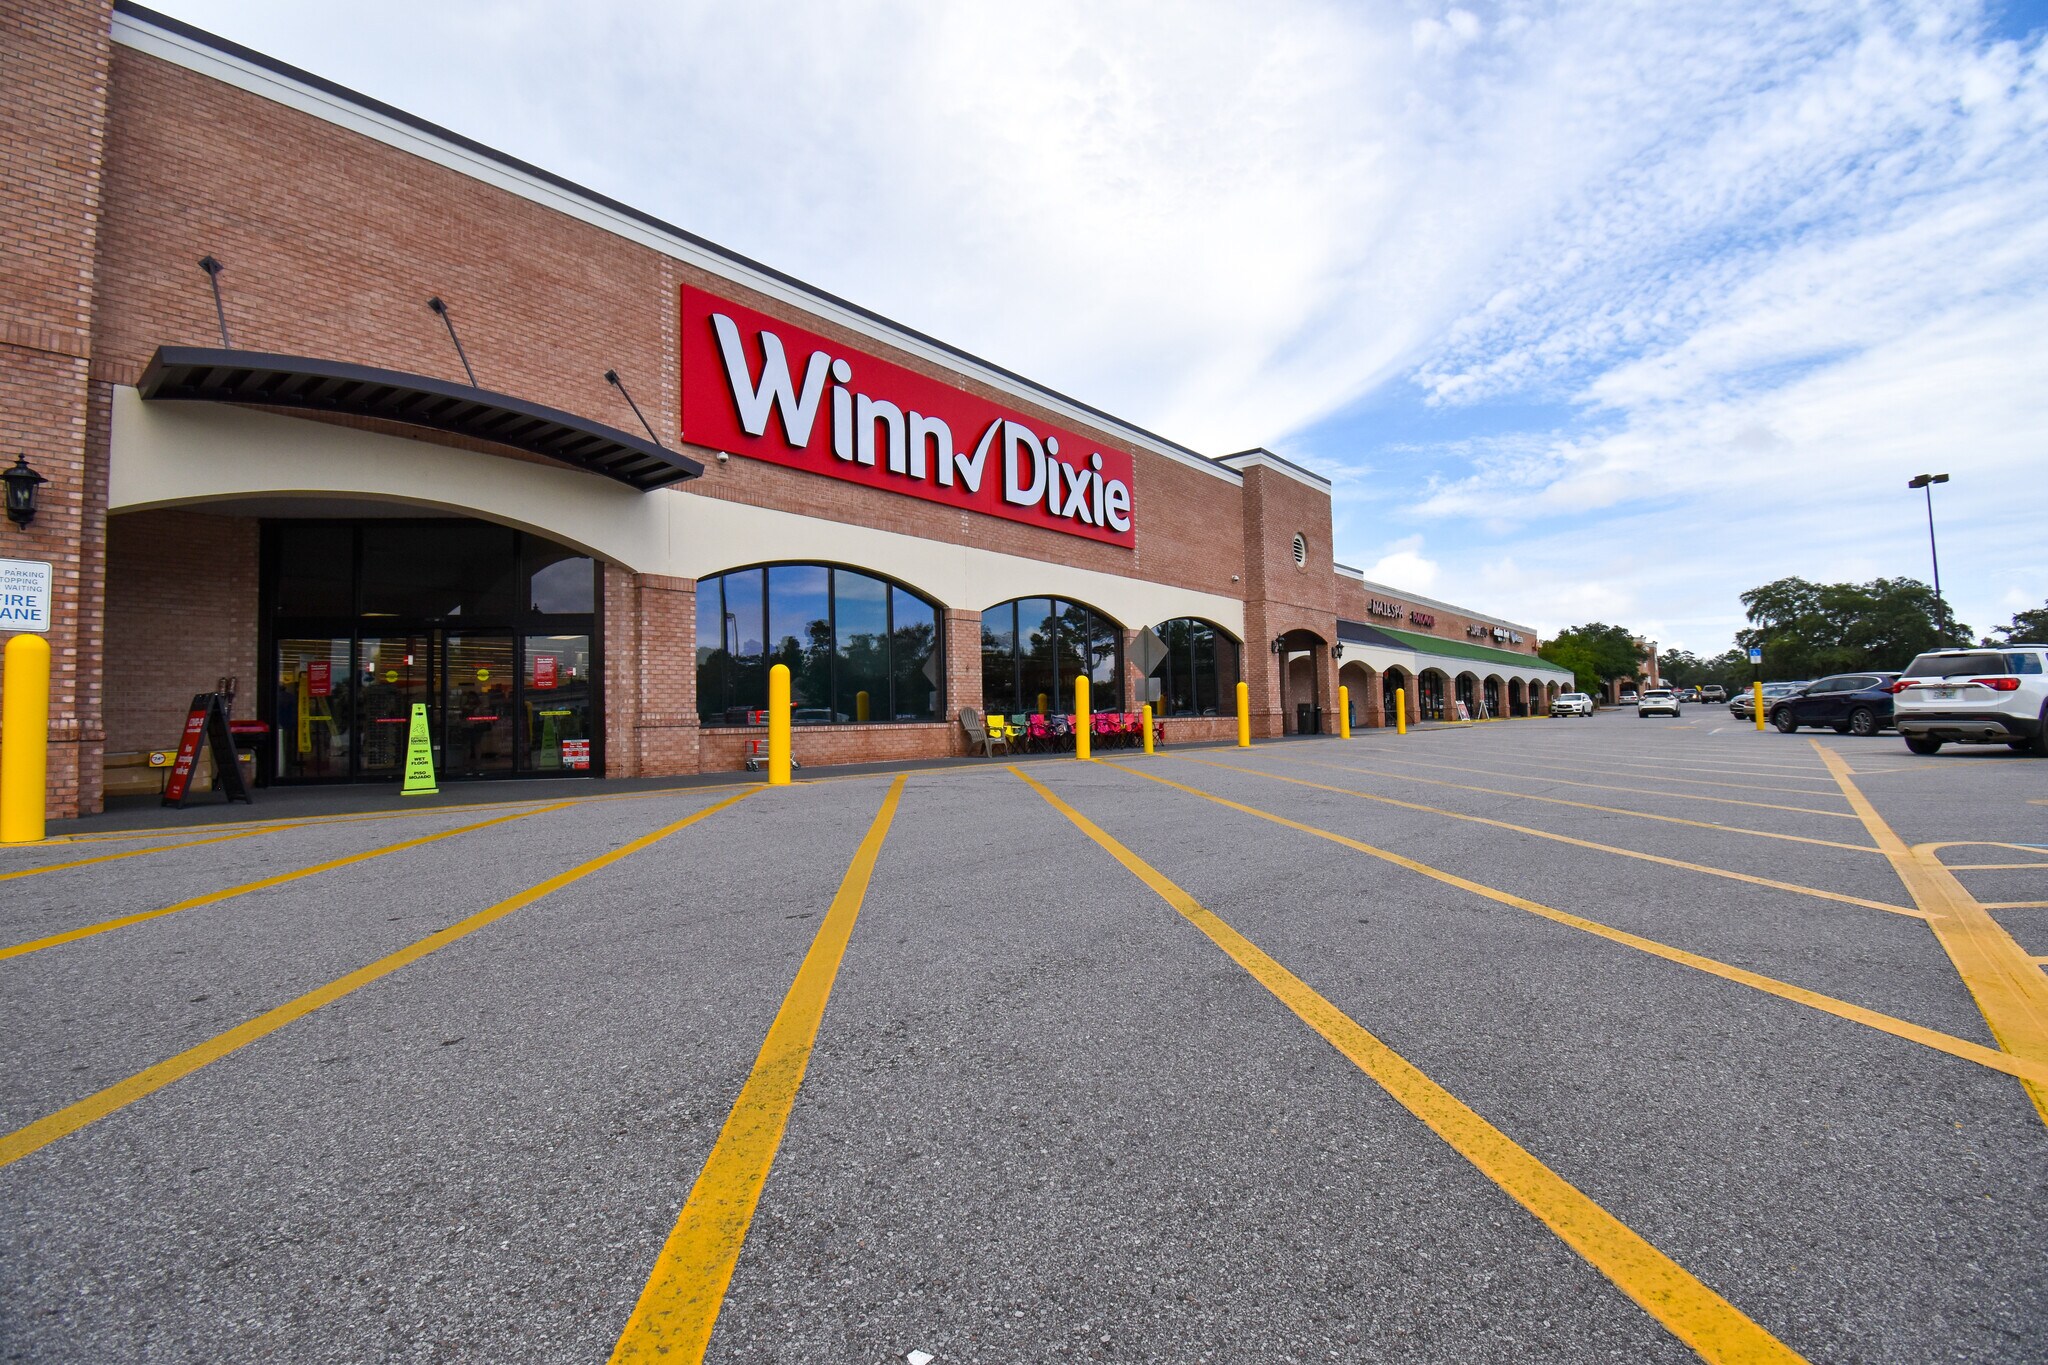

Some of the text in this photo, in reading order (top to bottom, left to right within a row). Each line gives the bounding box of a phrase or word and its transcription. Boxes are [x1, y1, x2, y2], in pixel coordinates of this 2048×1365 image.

[709, 313, 1131, 533] Winn Dixie
[4, 569, 44, 578] PARKING
[4, 584, 42, 592] WAITING
